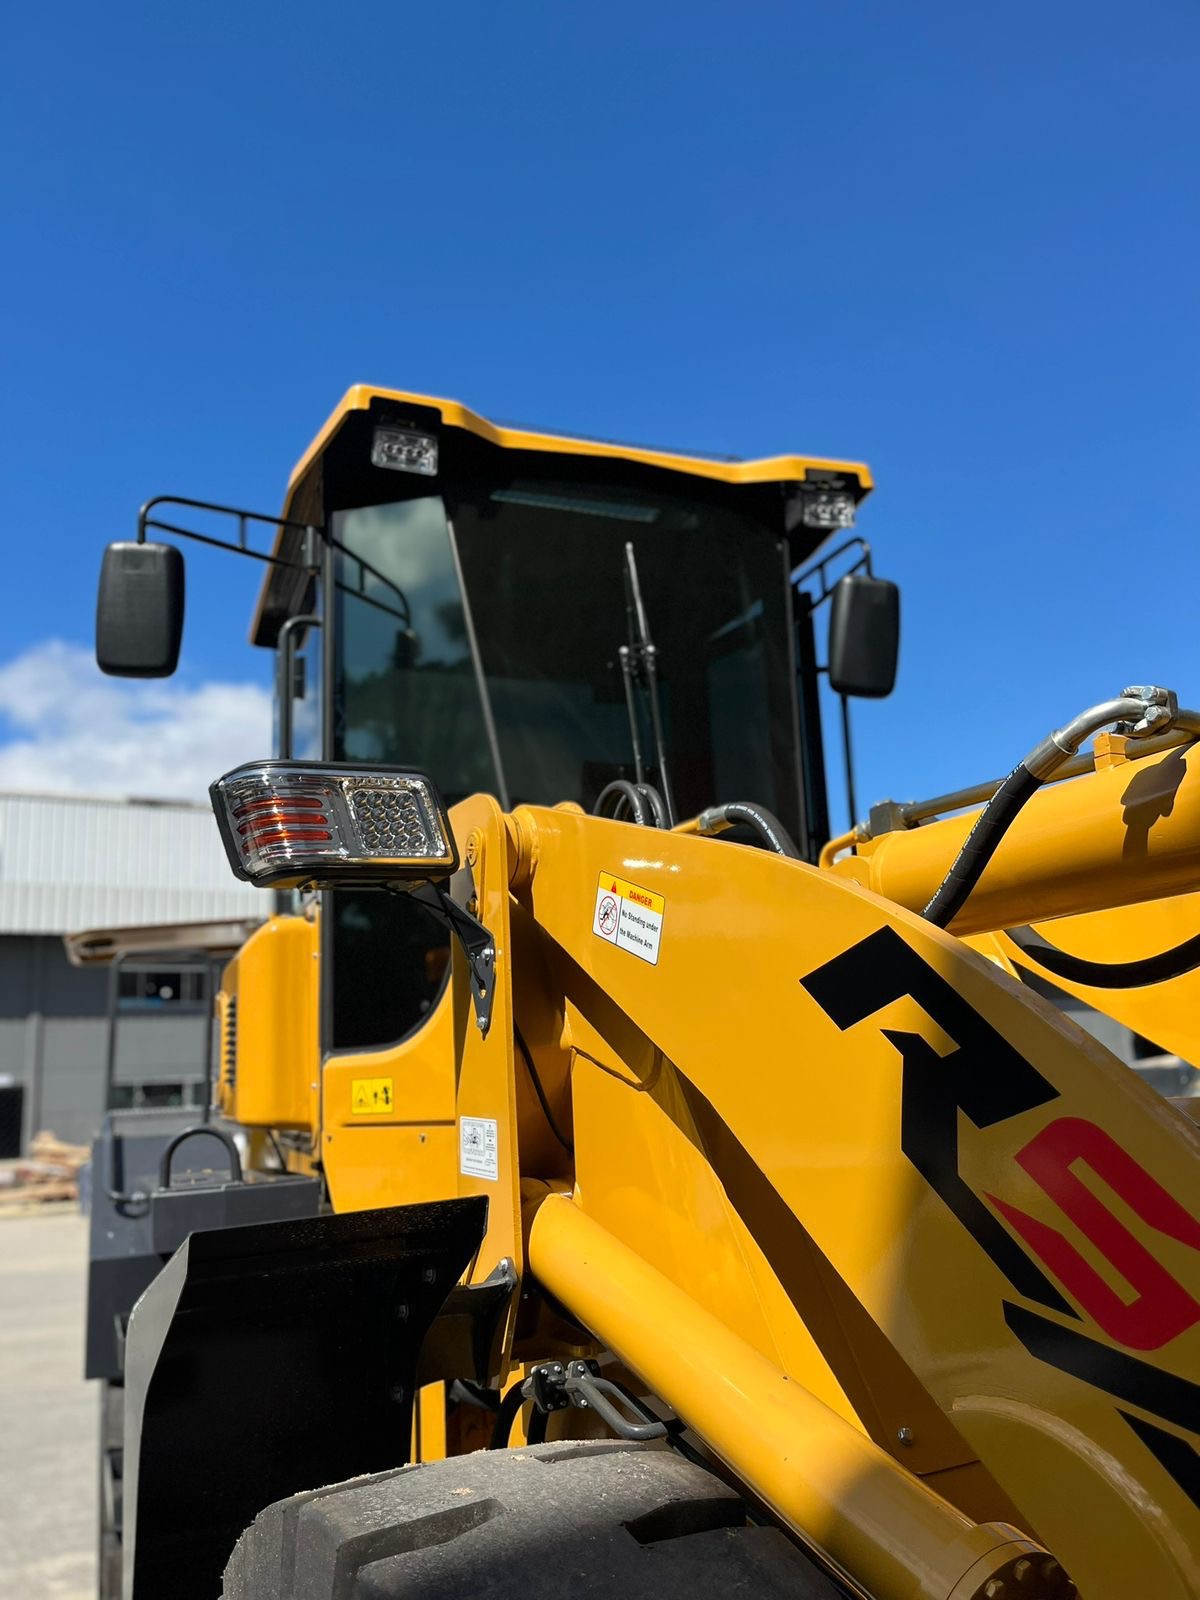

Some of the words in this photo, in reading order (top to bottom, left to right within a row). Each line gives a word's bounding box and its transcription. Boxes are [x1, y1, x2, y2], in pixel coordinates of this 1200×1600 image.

[629, 890, 652, 907] DANGER
[622, 910, 628, 918] No
[628, 912, 646, 928] Standing
[646, 922, 658, 932] under
[627, 931, 643, 945] Machine
[644, 939, 653, 949] Arm
